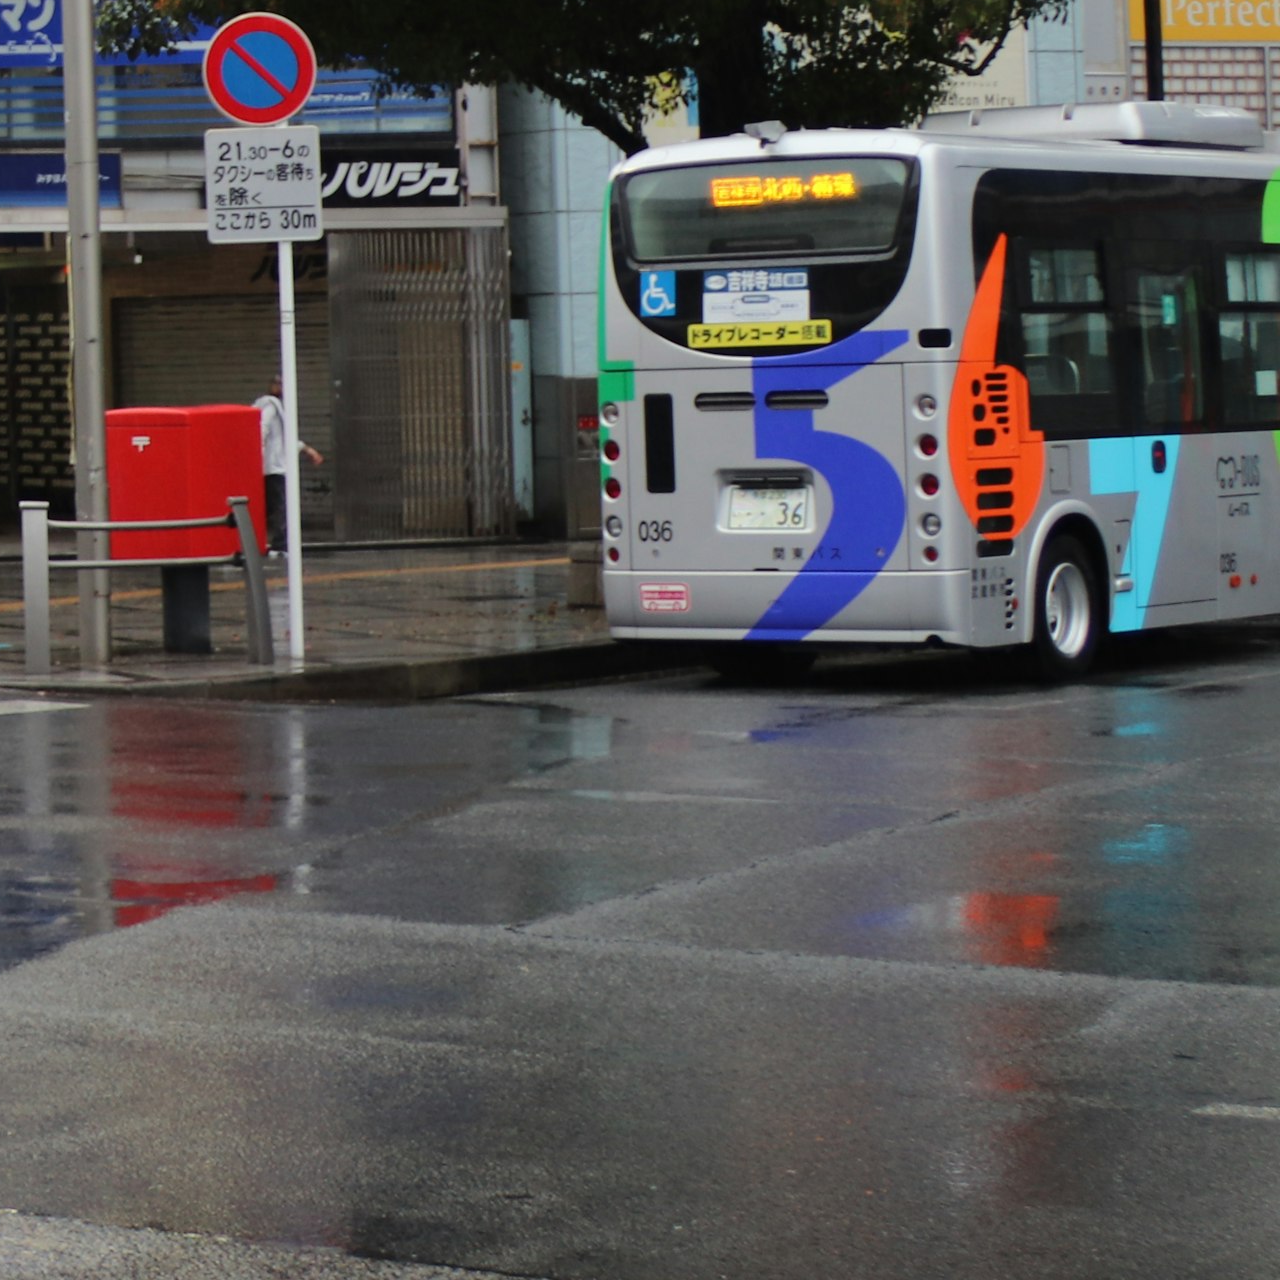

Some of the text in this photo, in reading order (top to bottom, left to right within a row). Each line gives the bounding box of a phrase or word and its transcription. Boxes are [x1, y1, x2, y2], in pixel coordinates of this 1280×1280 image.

[213, 163, 314, 184] タクシーの客待ち
[215, 187, 262, 206] を除く
[215, 209, 316, 231] ここから 30m
[692, 324, 828, 345] ドライブレコーダー搭載
[640, 520, 674, 542] 036
[773, 547, 842, 560] 関東バス
